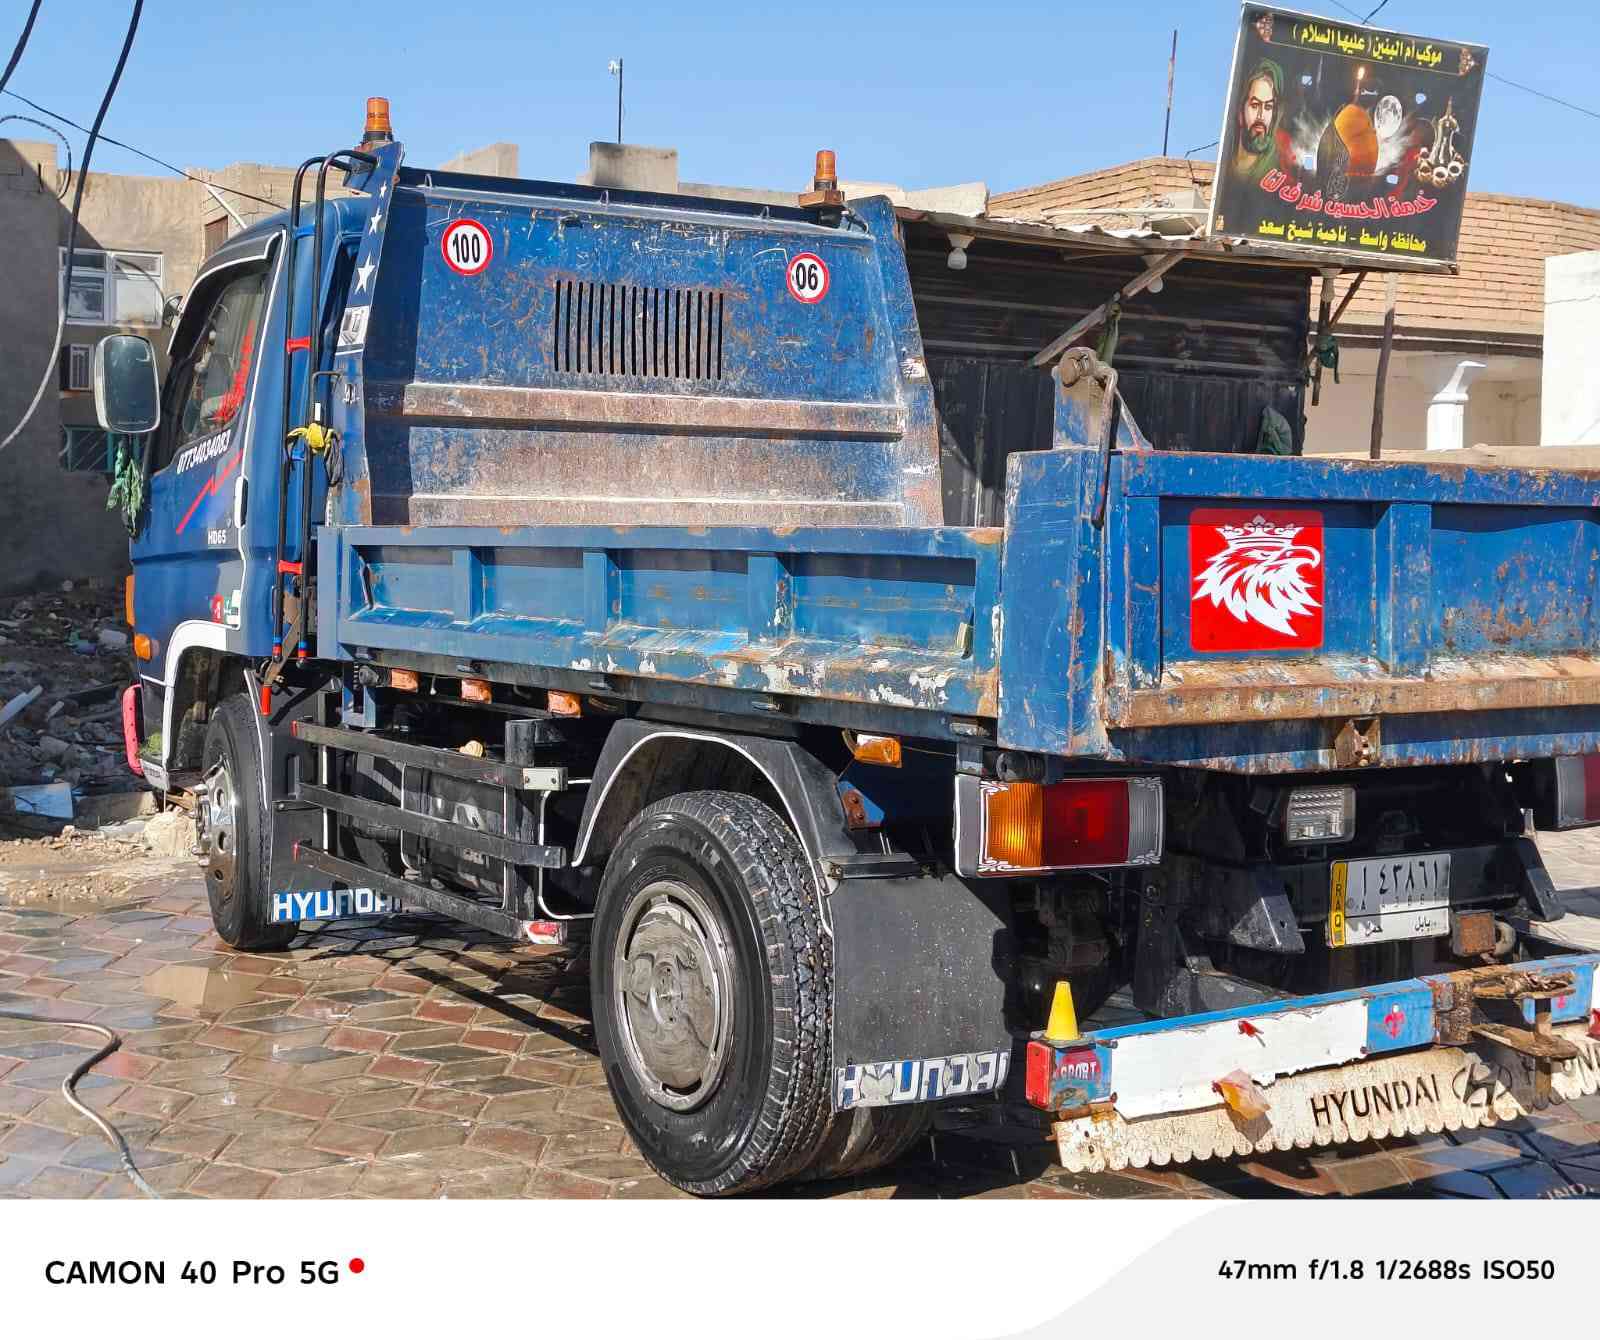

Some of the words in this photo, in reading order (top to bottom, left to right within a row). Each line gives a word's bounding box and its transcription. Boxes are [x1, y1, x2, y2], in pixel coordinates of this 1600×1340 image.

[1372, 36, 1404, 60] البنين
[1415, 44, 1443, 67] موكب
[1324, 196, 1390, 219] الحسين
[1390, 189, 1438, 217] خدمة
[1258, 219, 1285, 236] سعد
[1287, 219, 1314, 241] شيخ
[1316, 221, 1348, 244] ناحية
[1359, 227, 1389, 251] واسط
[452, 233, 481, 263] 100
[1390, 230, 1427, 252] محافظة
[207, 529, 227, 545] HD65
[1310, 1073, 1441, 1127] HYUNDAI
